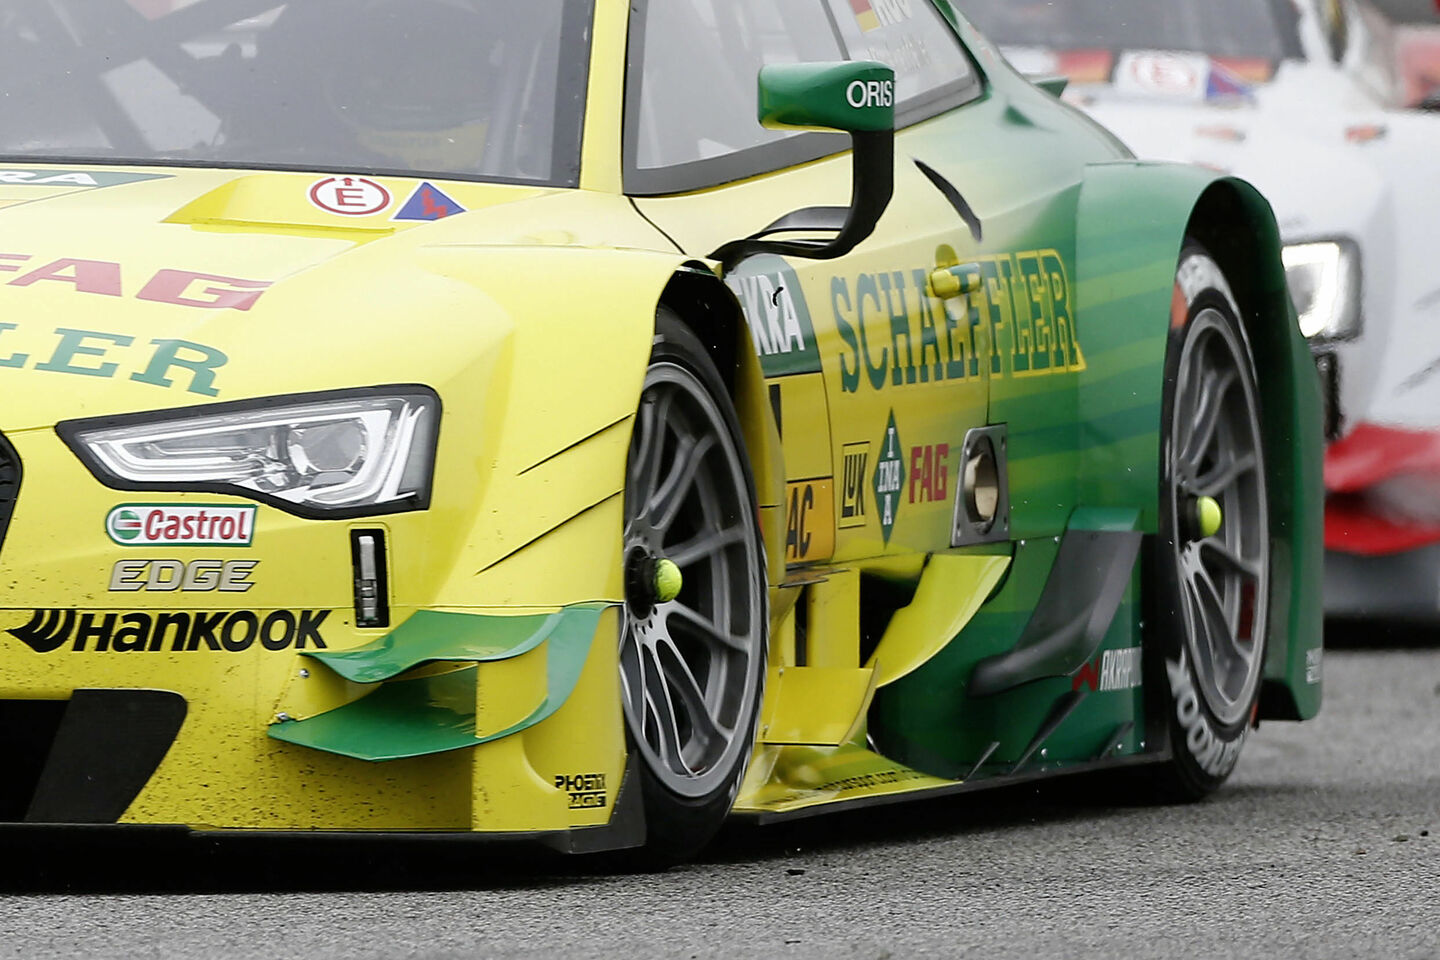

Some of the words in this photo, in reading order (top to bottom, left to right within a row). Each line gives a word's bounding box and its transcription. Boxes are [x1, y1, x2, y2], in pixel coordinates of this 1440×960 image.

[846, 80, 893, 108] ORIS
[909, 443, 950, 505] FAG
[144, 509, 248, 541] Castrol
[107, 559, 260, 592] EDGE
